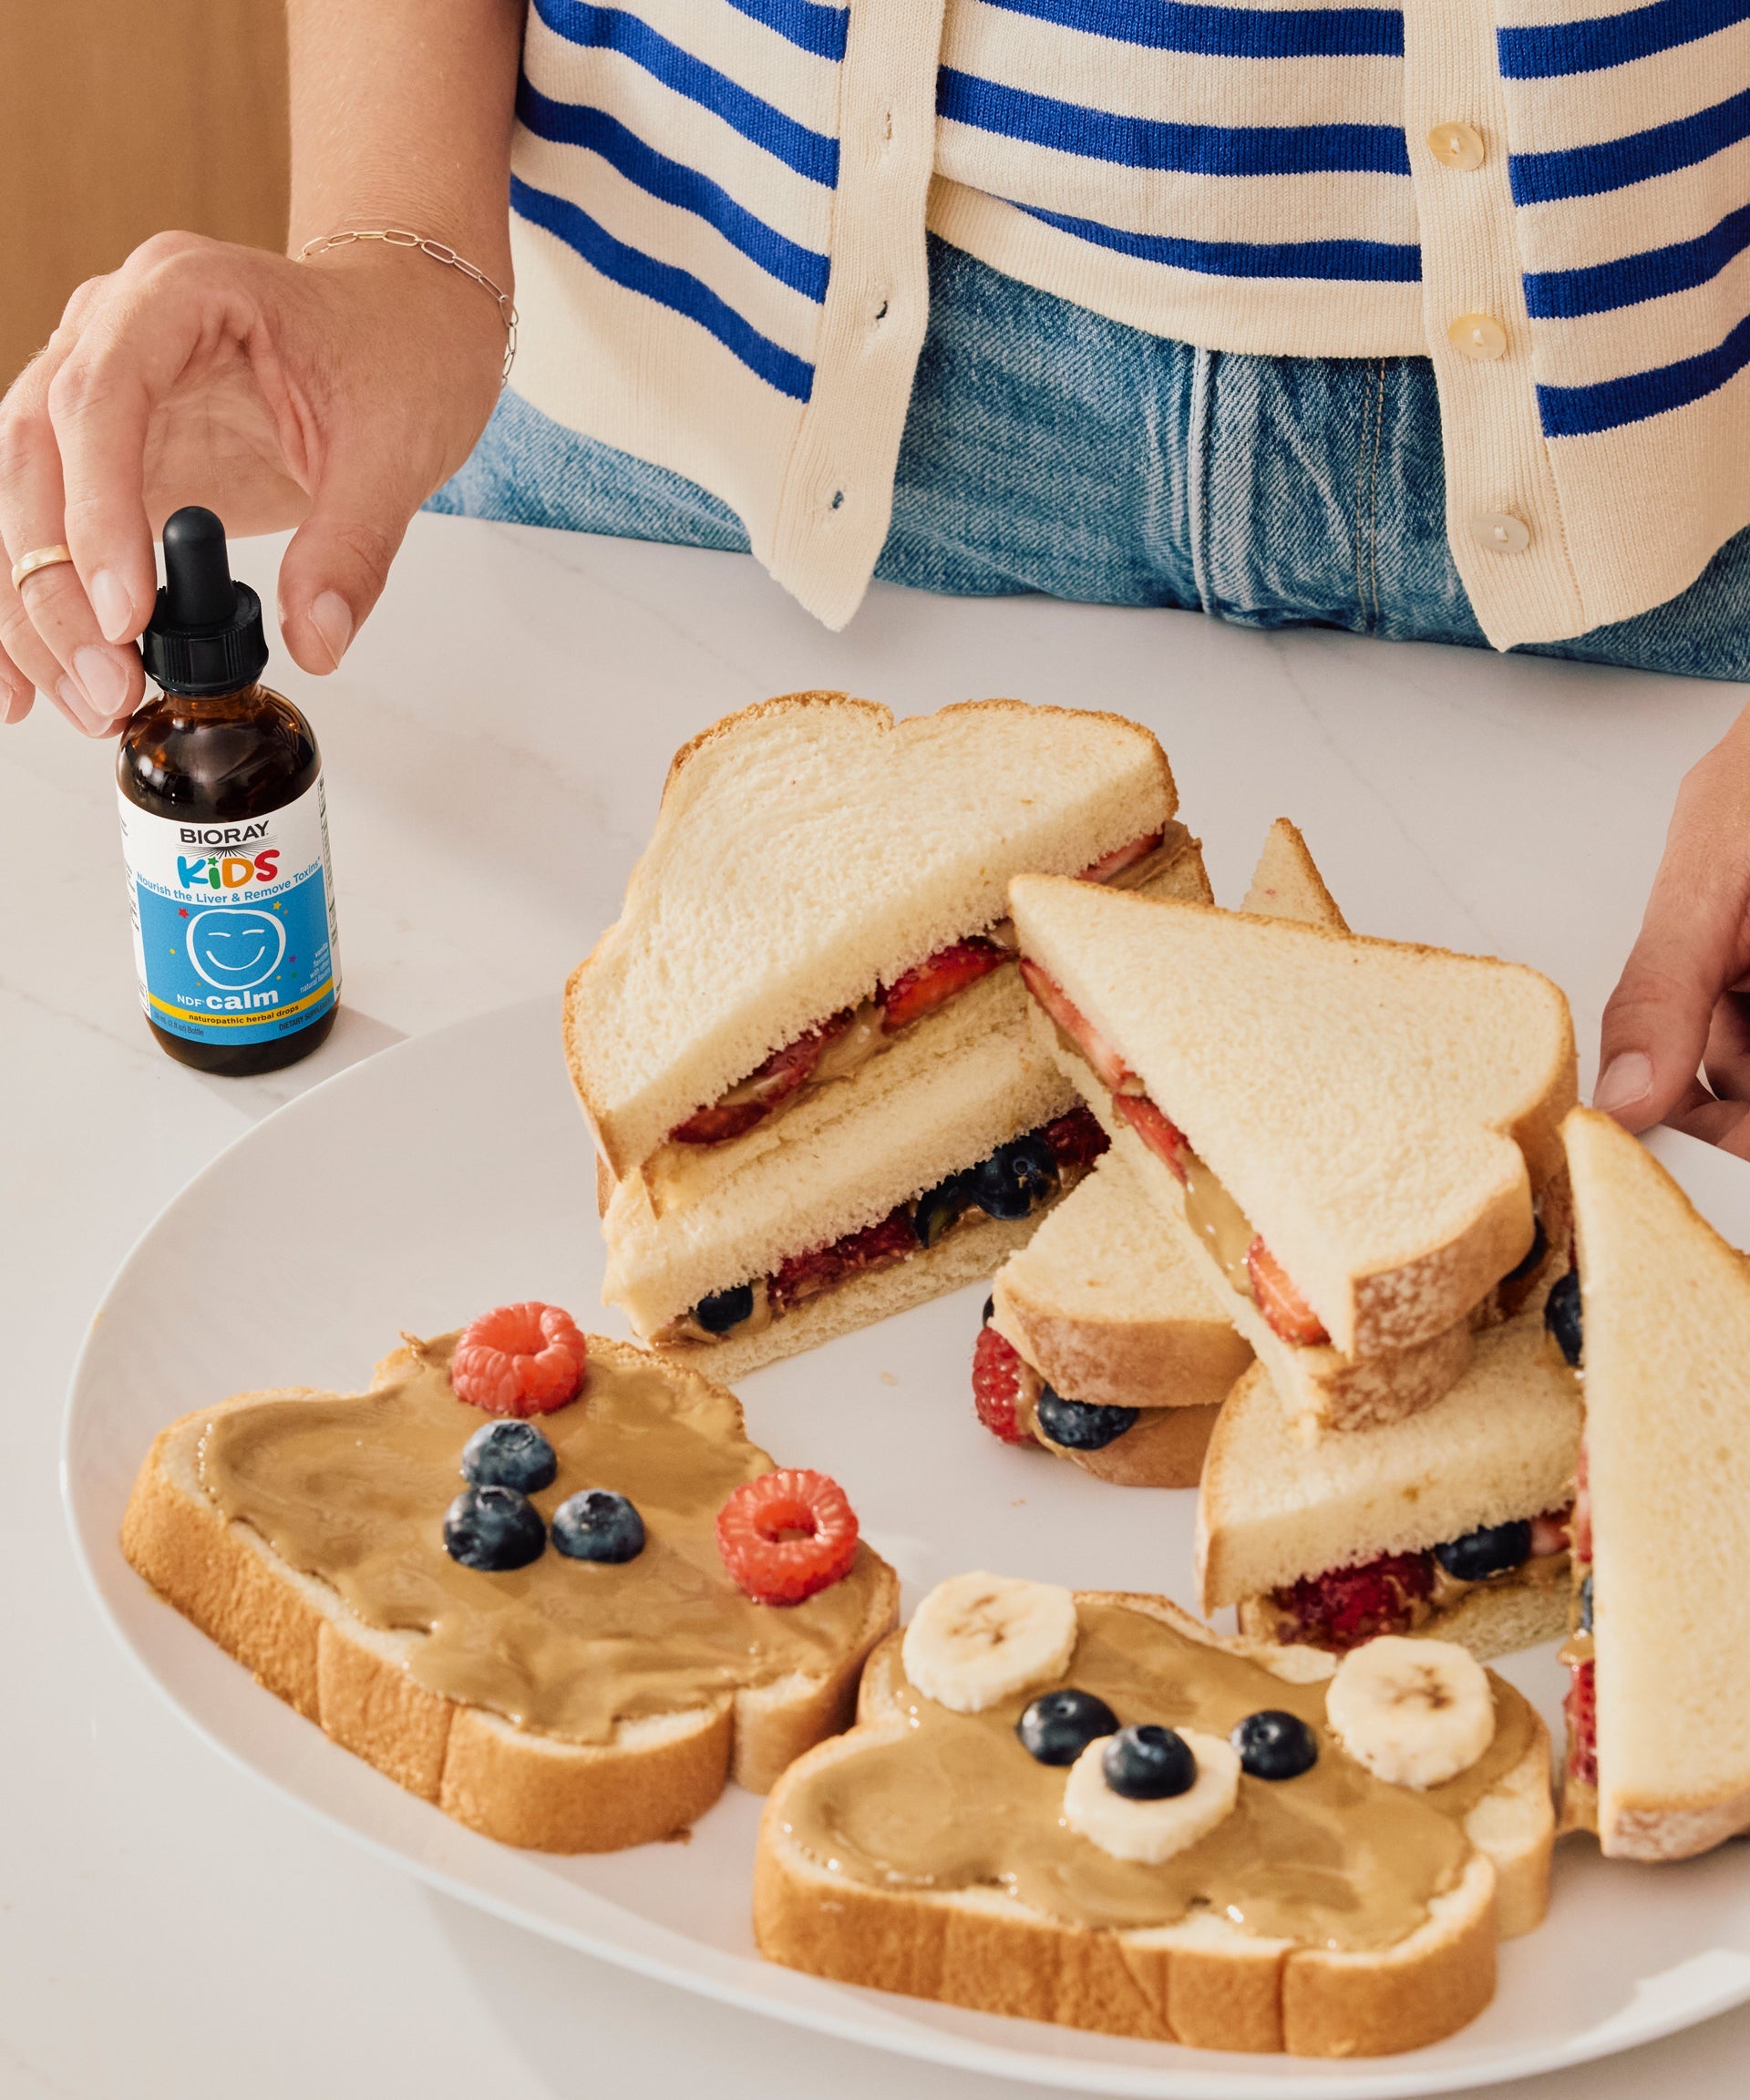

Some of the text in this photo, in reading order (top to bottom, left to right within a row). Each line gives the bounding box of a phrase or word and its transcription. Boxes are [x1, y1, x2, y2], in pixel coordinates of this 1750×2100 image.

[180, 819, 269, 844] BIORAY
[137, 871, 171, 896] Nourish
[173, 890, 192, 901] the
[196, 893, 227, 903] Liver
[232, 892, 241, 902] &
[245, 880, 291, 901] Remove
[300, 977, 318, 993] natural
[206, 990, 279, 1010] calm
[189, 1005, 299, 1024] naturopathic herbal drops
[279, 1016, 304, 1031] DIETARY
[188, 1026, 204, 1035] Bottle
